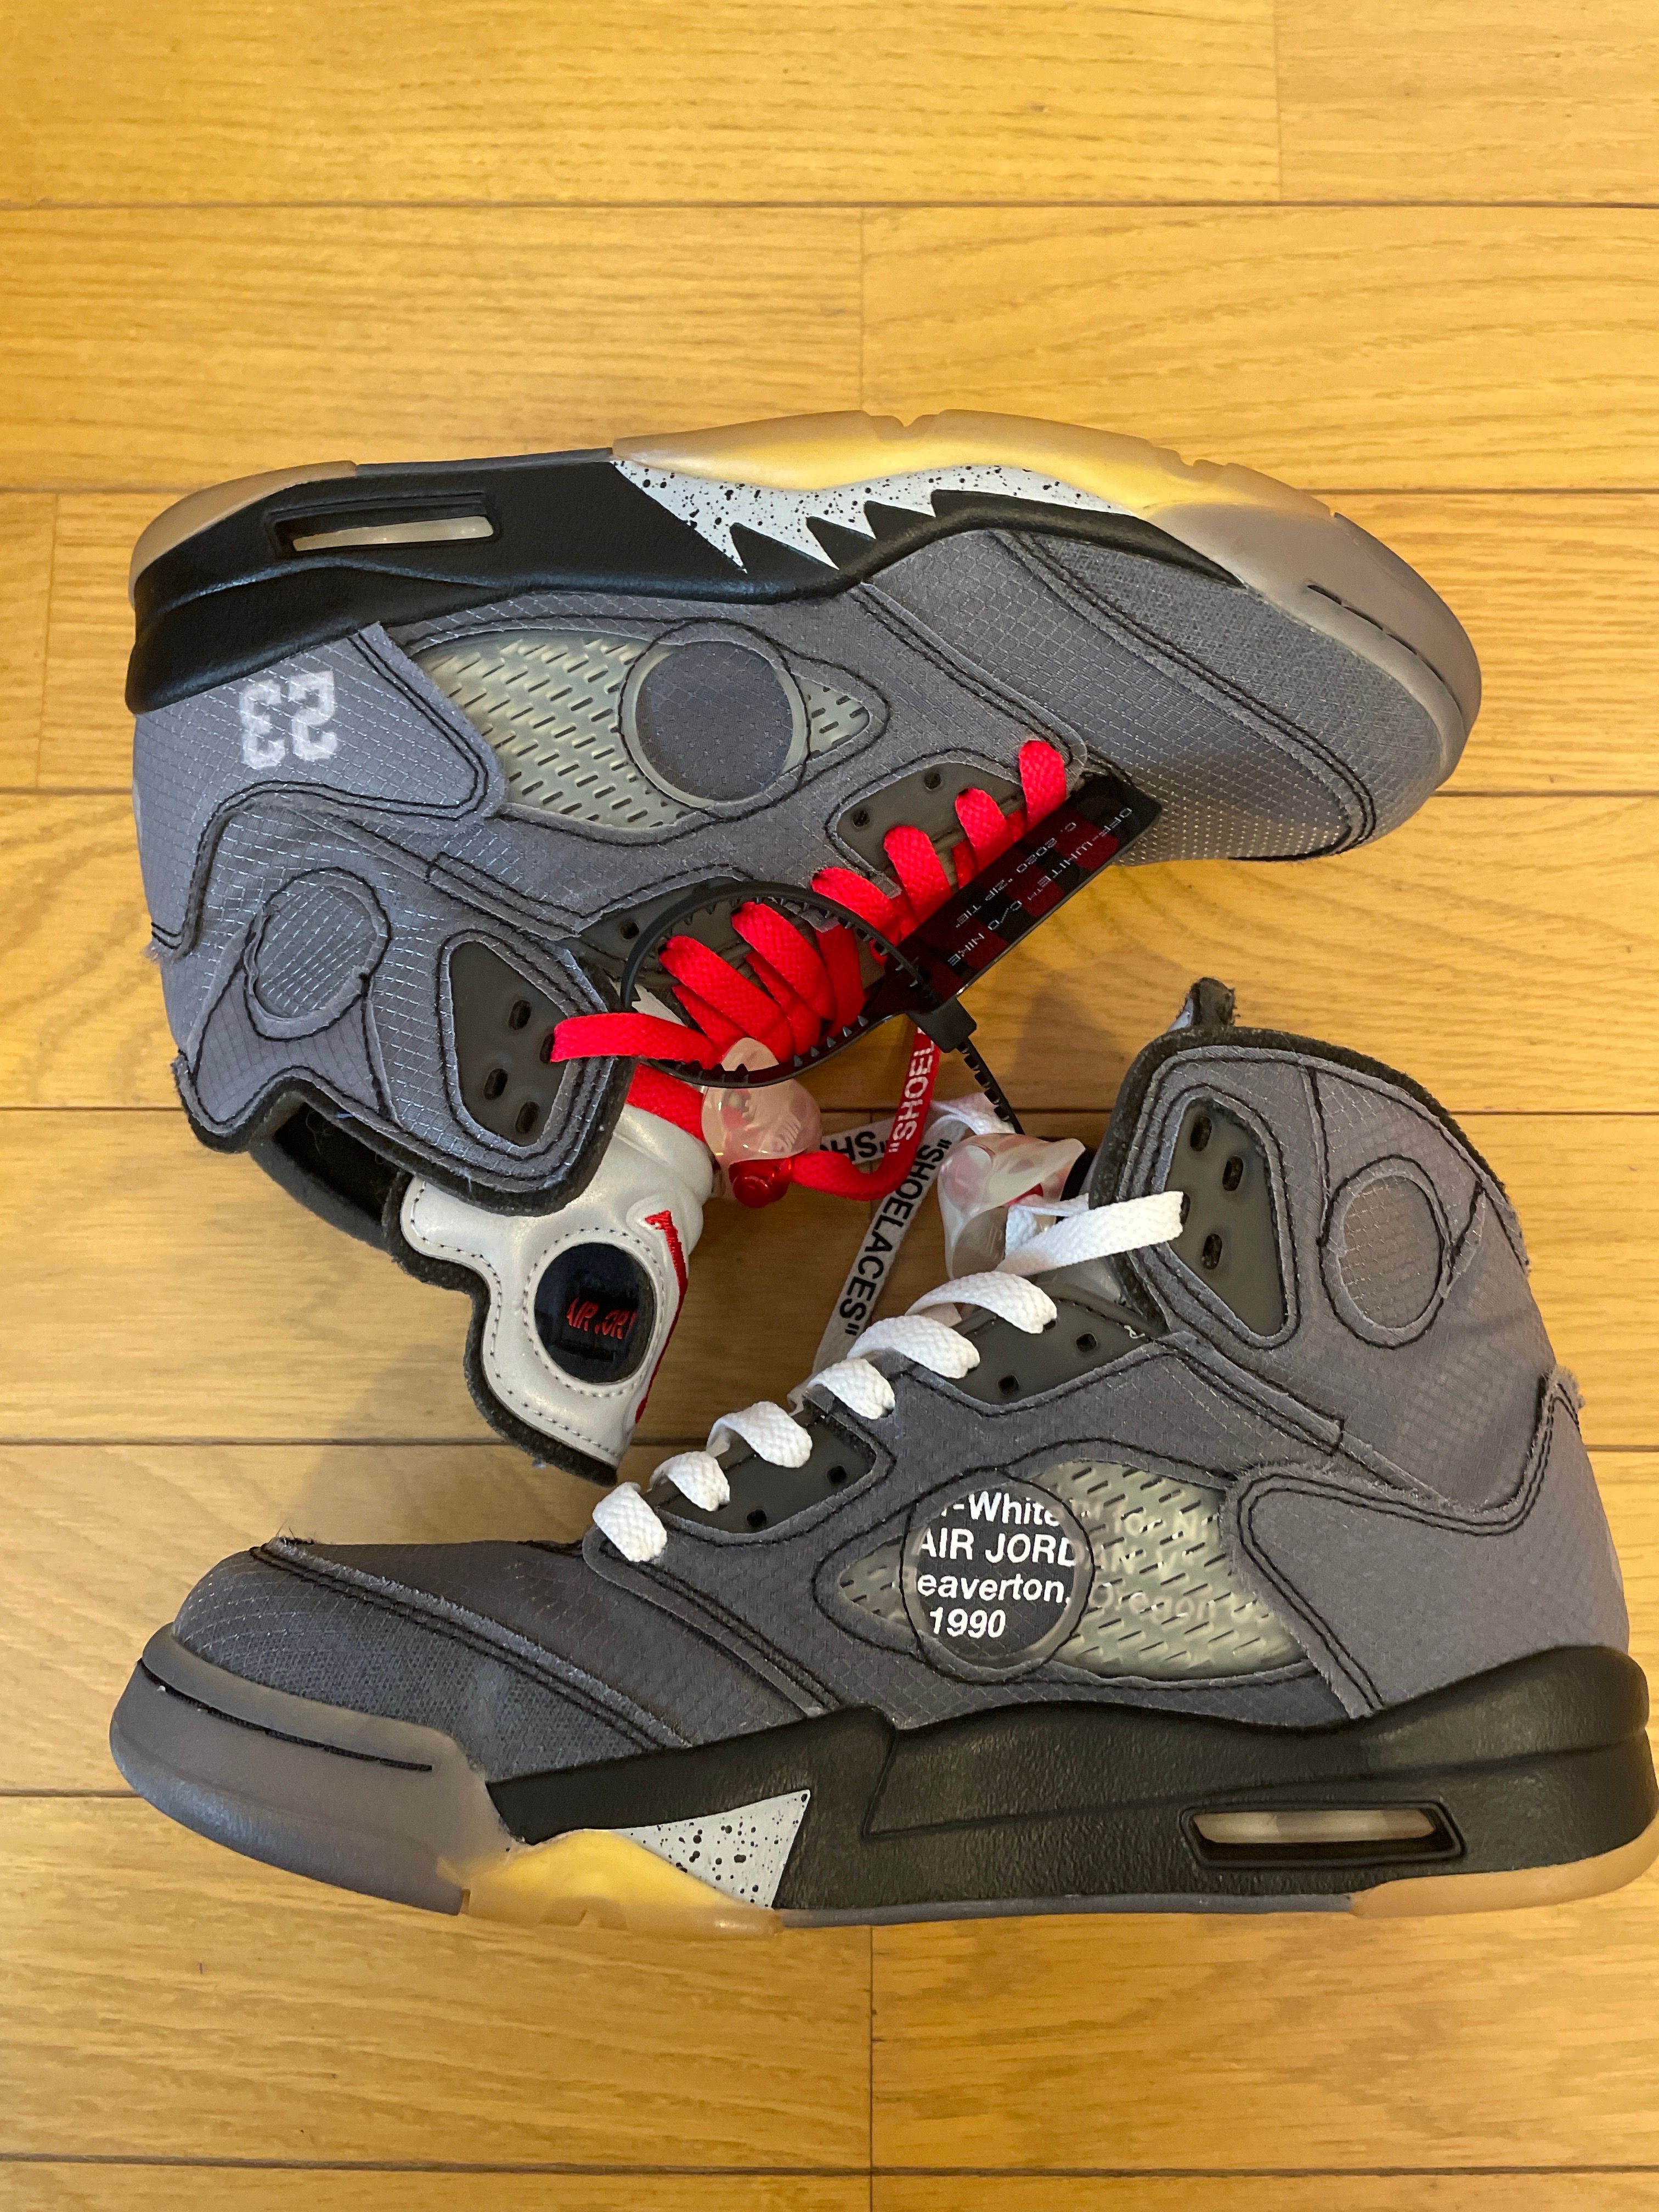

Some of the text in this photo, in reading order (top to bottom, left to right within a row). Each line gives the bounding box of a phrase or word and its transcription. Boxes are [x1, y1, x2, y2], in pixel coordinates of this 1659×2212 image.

[240, 670, 338, 770] 23
[1016, 837, 1058, 874] 2020
[947, 932, 985, 967] NIKE
[888, 1027, 934, 1153] "SHOEL
[839, 1138, 952, 1336] "SHOELACES"
[920, 1527, 974, 1560] AIR
[929, 1606, 1006, 1639] 1990
